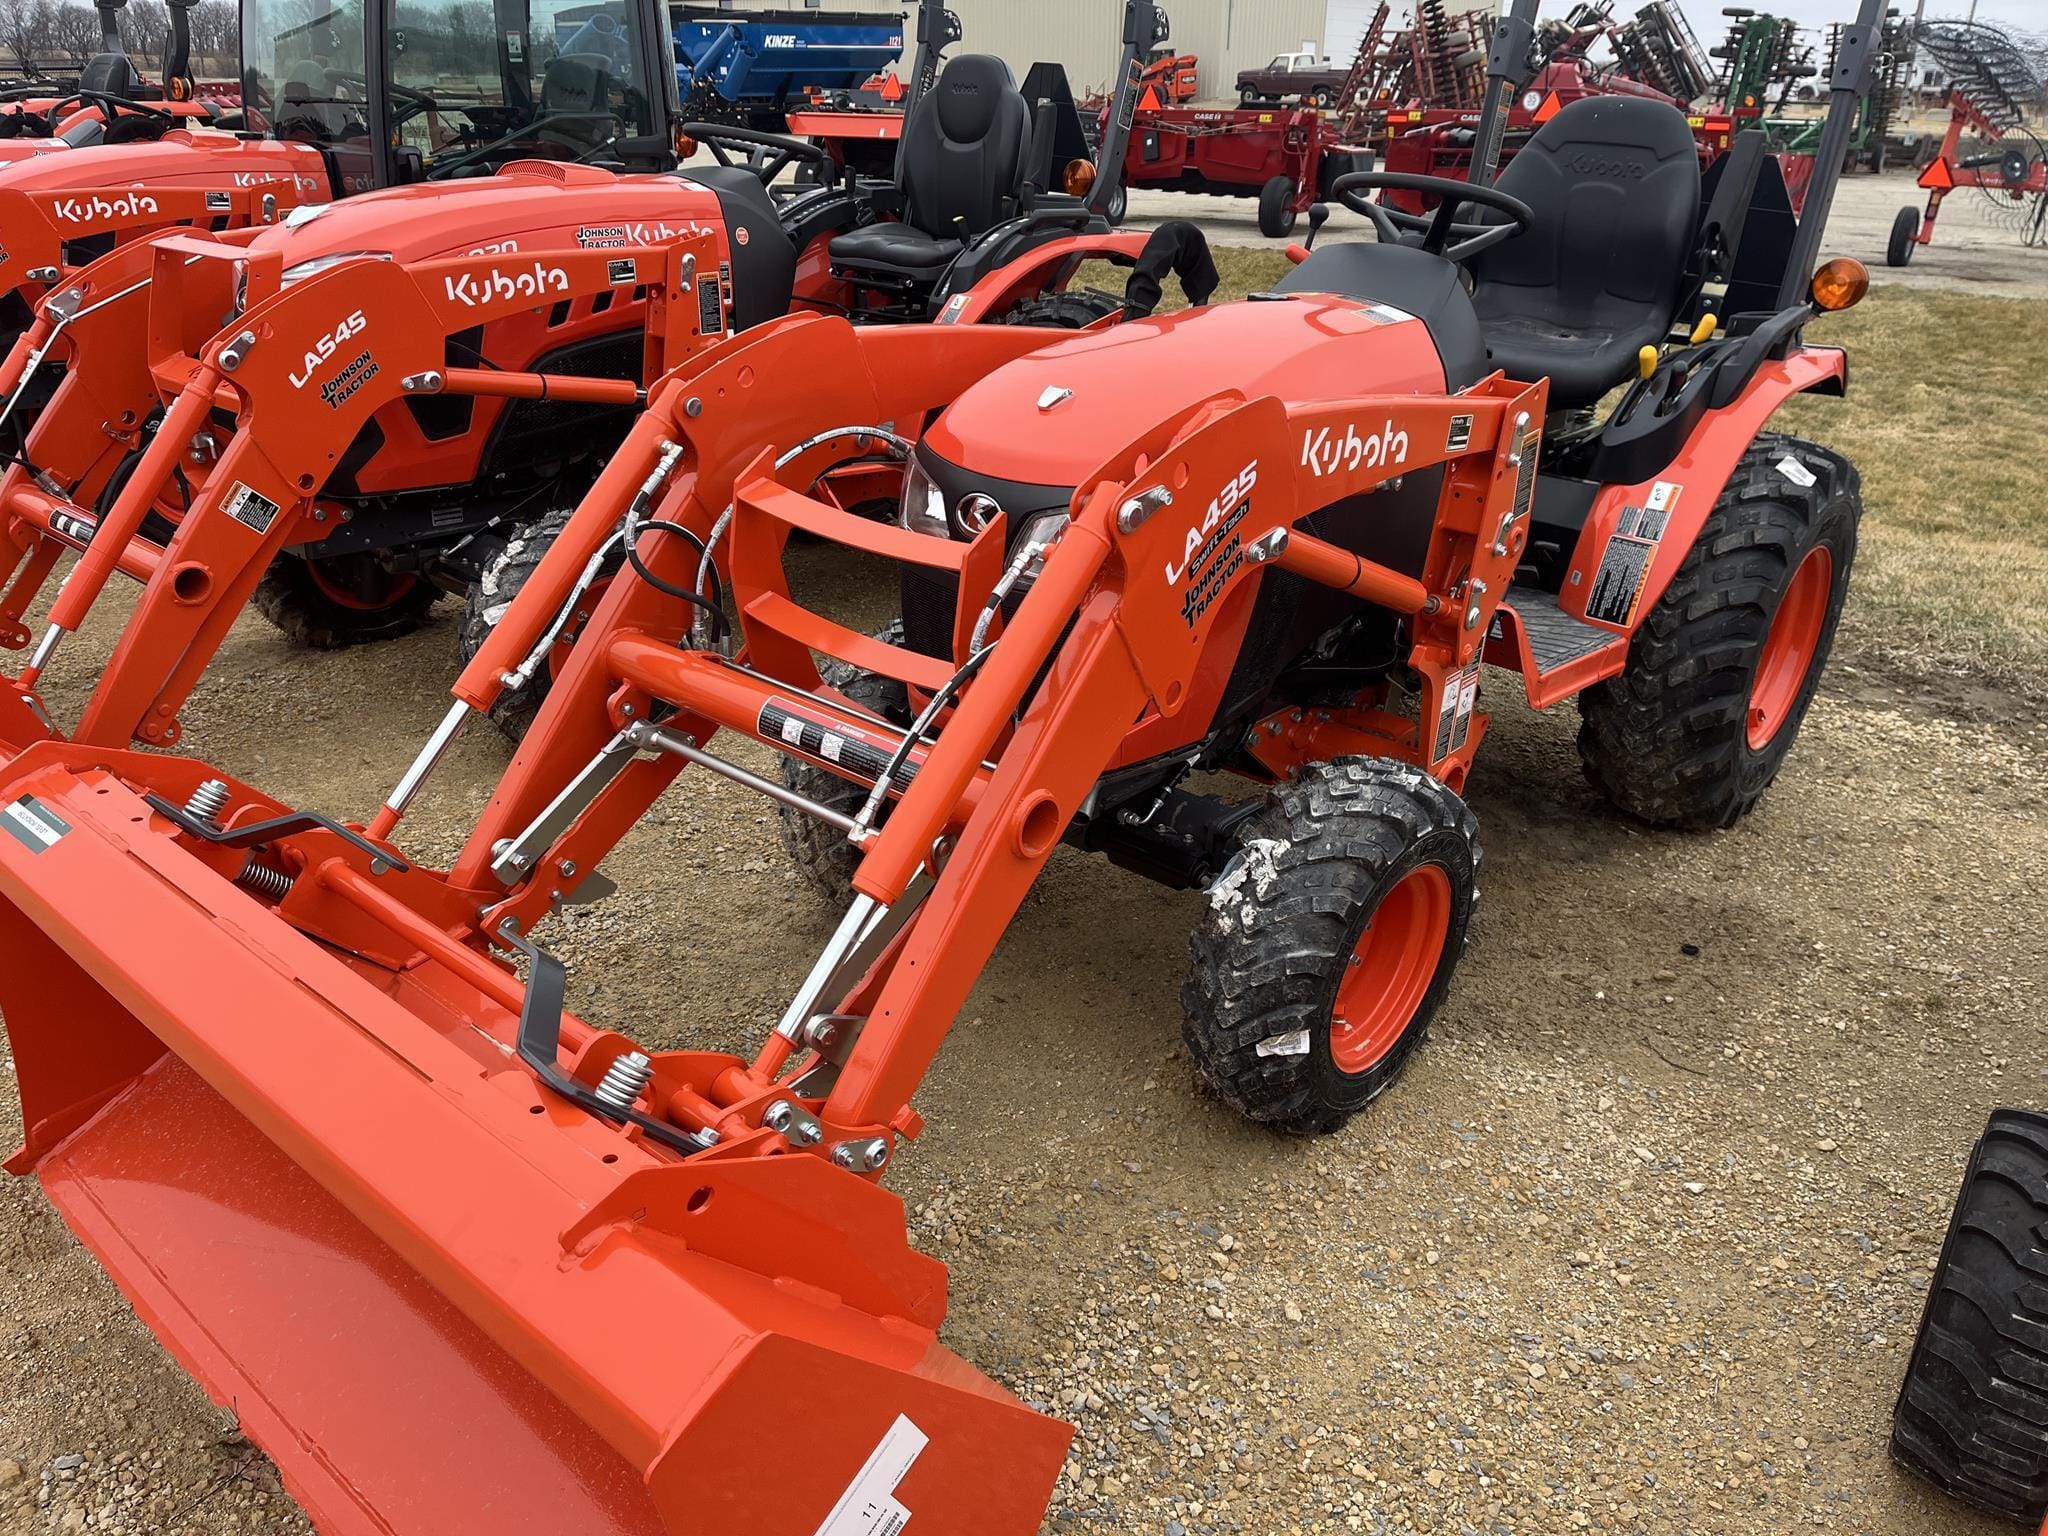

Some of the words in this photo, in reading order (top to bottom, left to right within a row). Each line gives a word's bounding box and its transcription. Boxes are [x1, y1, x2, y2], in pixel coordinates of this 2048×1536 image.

[764, 34, 797, 48] KINZE
[889, 36, 901, 46] 1121
[234, 173, 317, 191] Kubta
[54, 191, 159, 224] Kubota
[577, 225, 623, 238] JOHNSON
[579, 238, 625, 249] TRACTOR
[445, 262, 569, 306] Kubota
[288, 309, 367, 389] LA545
[320, 350, 371, 400] JOHNSON
[326, 363, 379, 410] TRACTOR
[1301, 420, 1409, 477] Kubota
[1164, 458, 1258, 587] LA435
[1190, 503, 1249, 577] Swift-Tach
[1181, 532, 1241, 617] JOHNSON
[1183, 550, 1244, 629] TRACTOR
